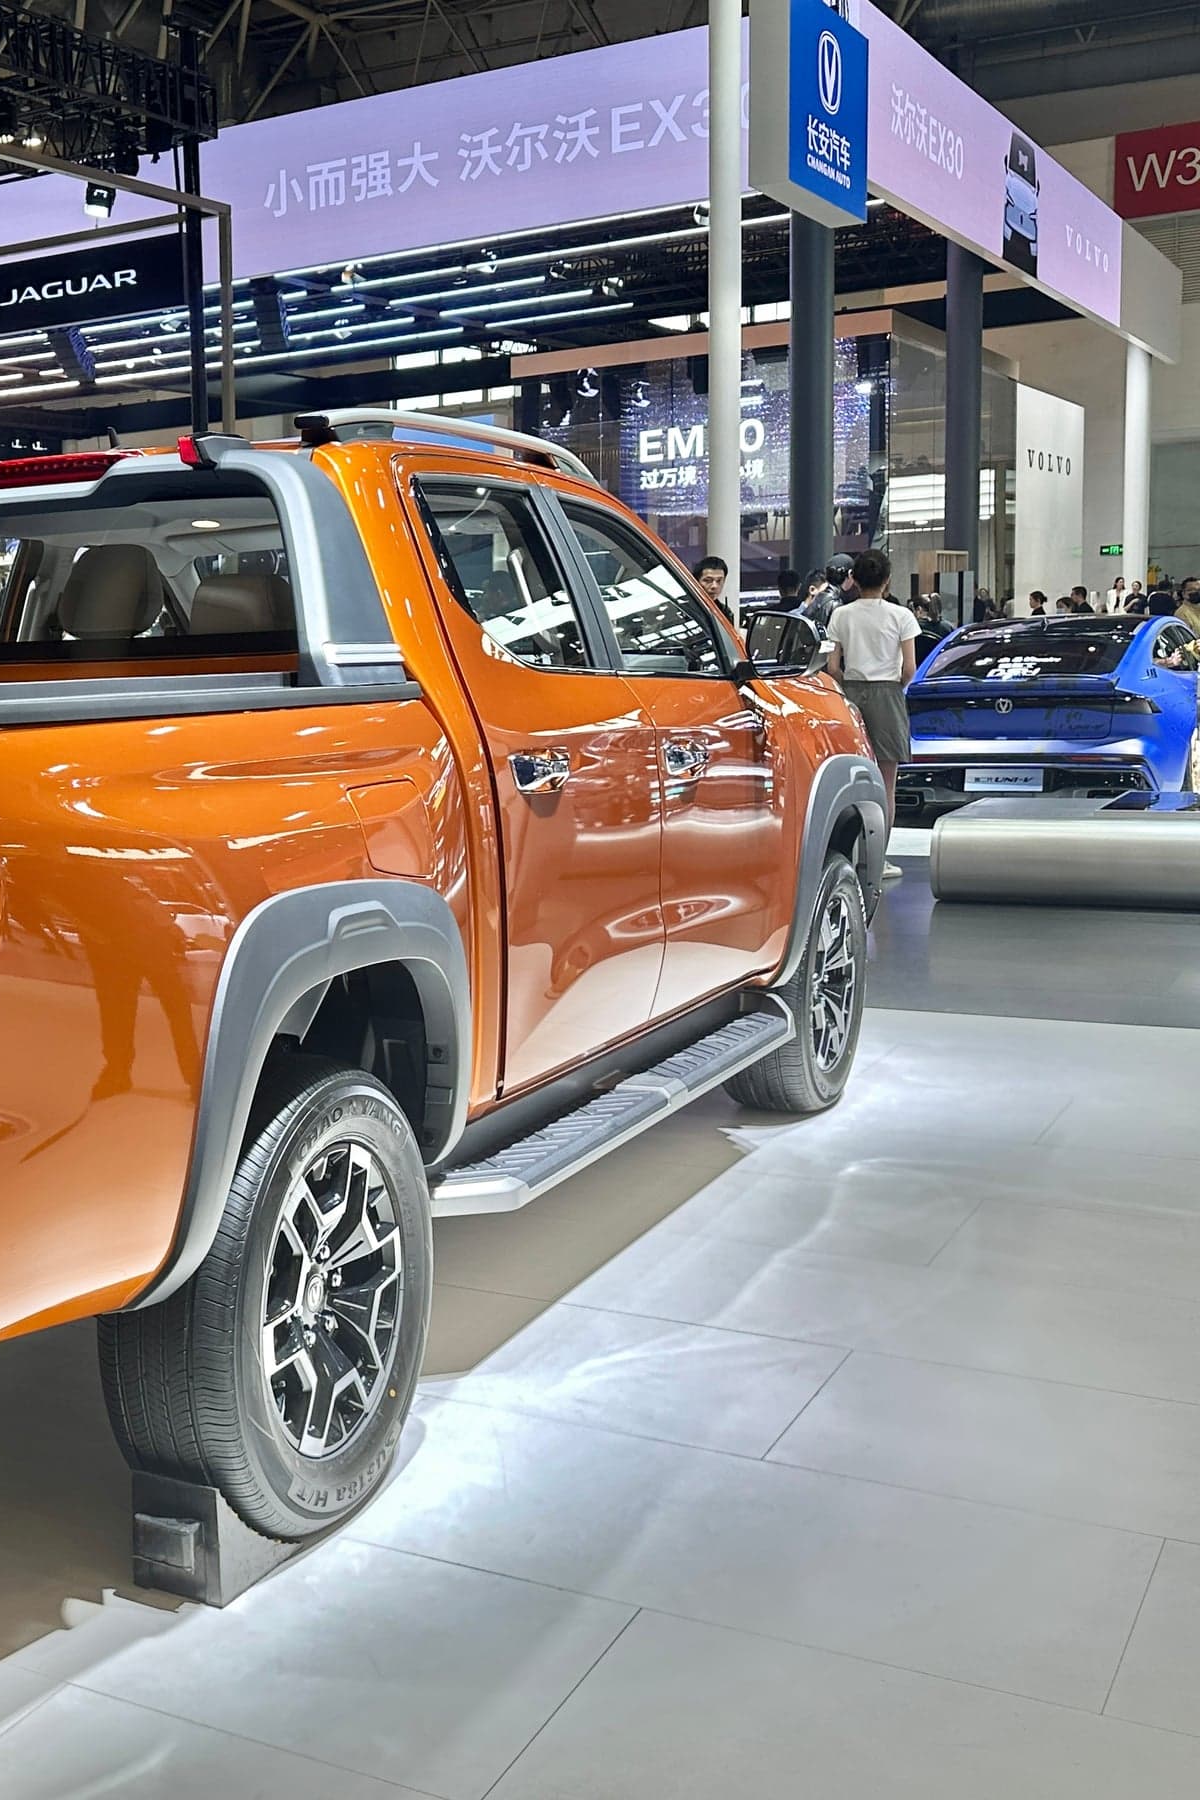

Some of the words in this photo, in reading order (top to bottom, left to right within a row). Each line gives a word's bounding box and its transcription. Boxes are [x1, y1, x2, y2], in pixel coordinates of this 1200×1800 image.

[807, 114, 850, 171] 长安汽车
[263, 142, 439, 218] 小而强大
[807, 153, 835, 181] CHANGAN
[835, 170, 851, 190] AUTO
[1065, 224, 1109, 273] VOLVO
[0, 269, 137, 307] JAGUAR
[1027, 449, 1071, 476] VOLVO
